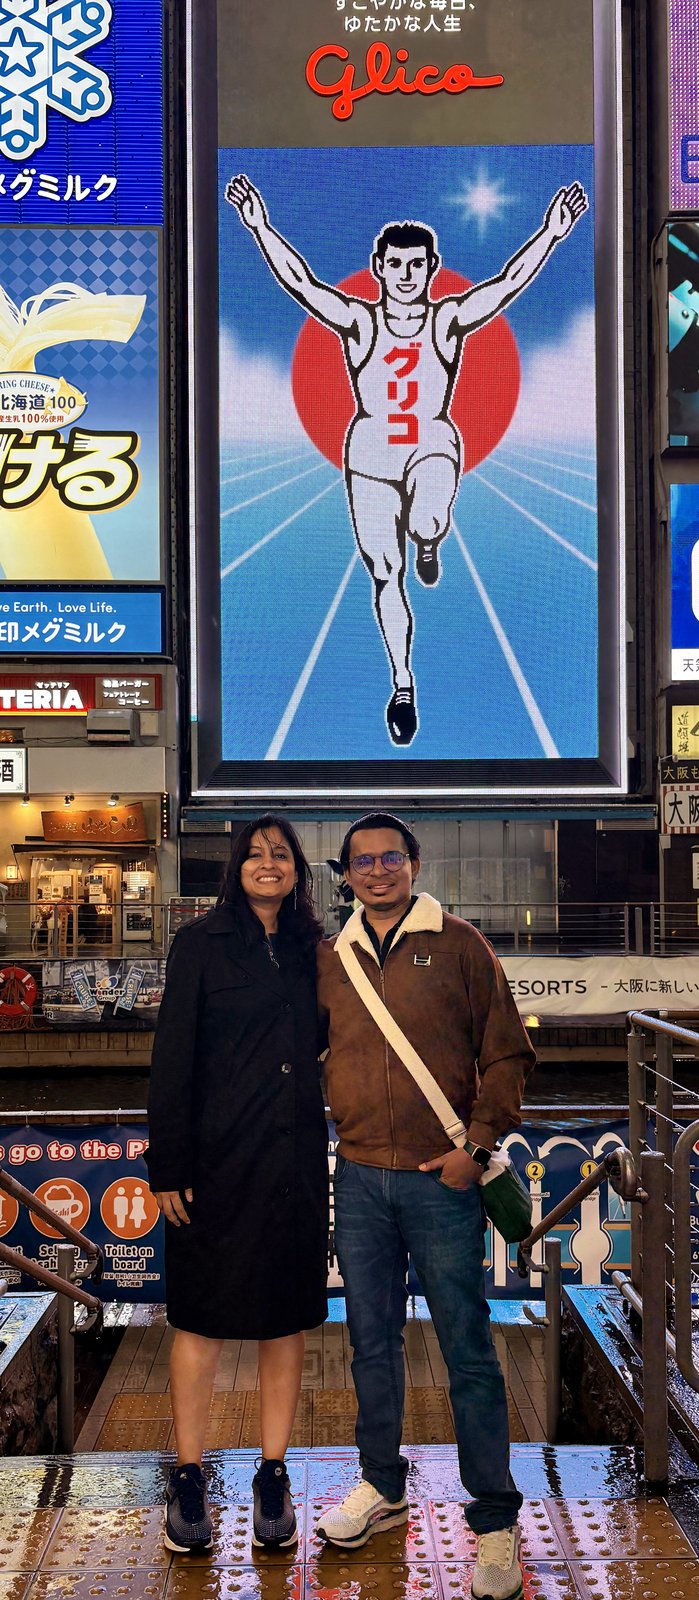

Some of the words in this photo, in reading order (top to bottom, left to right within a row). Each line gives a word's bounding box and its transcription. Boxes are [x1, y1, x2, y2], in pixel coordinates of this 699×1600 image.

[344, 15, 462, 32] ゆたかな人生
[305, 41, 504, 120] Glico
[20, 379, 50, 392] CHEESE
[384, 342, 422, 444] グリコ
[50, 396, 76, 409] 100
[13, 602, 52, 613] Earth.
[58, 602, 86, 613] Love
[90, 602, 117, 613] Life.
[683, 658, 699, 673] 天
[0, 689, 84, 709] TERIA
[118, 698, 149, 706] コーヒー
[89, 988, 125, 996] Wonder
[9, 1144, 43, 1165] go
[47, 1140, 76, 1160] to
[80, 1139, 122, 1159] the
[532, 1165, 538, 1176] 2
[587, 1164, 592, 1175] 1
[105, 1245, 137, 1257] Toilet
[138, 1248, 154, 1257] on
[113, 1258, 146, 1270] board
